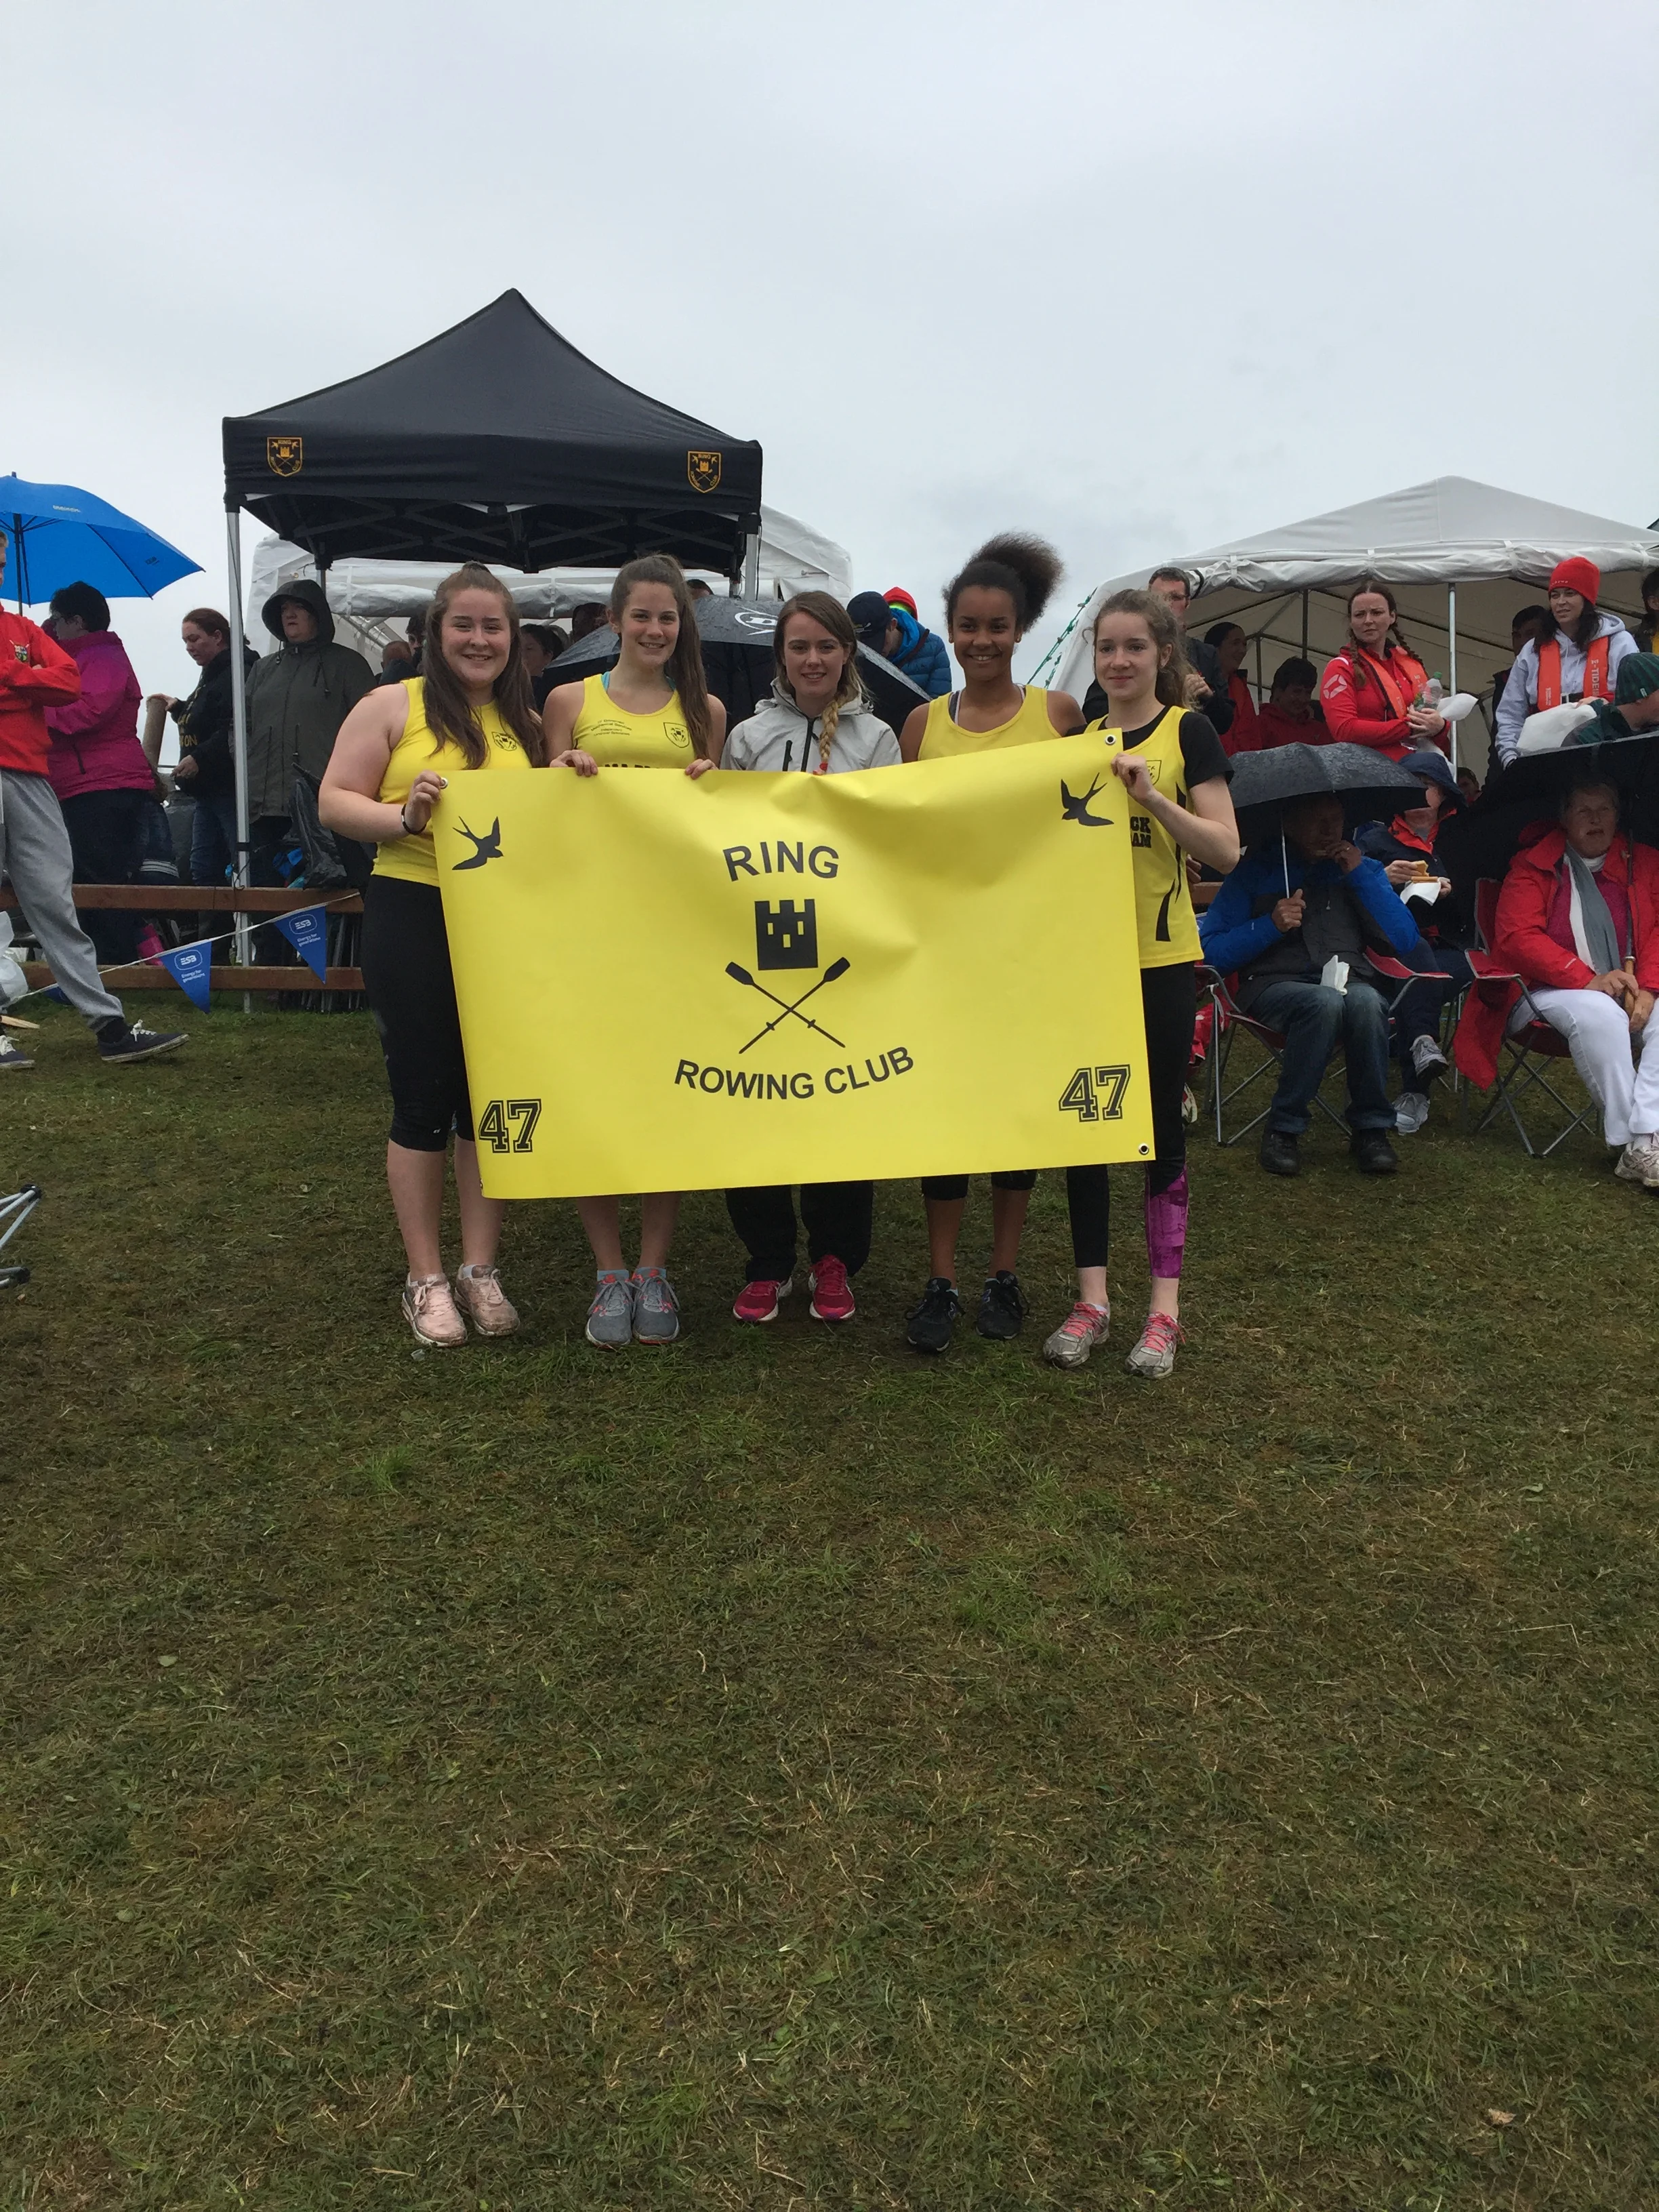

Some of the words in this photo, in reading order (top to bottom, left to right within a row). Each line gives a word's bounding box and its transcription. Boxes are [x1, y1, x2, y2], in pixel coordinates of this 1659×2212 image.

[1130, 816, 1151, 834] CK
[1131, 832, 1152, 848] AM
[722, 840, 840, 882] RING
[294, 919, 312, 930] ESB
[180, 955, 197, 966] ESB
[674, 1059, 815, 1100] ROWING
[824, 1046, 915, 1094] CLUB
[1058, 1064, 1131, 1122] 47
[478, 1098, 542, 1153] 47
